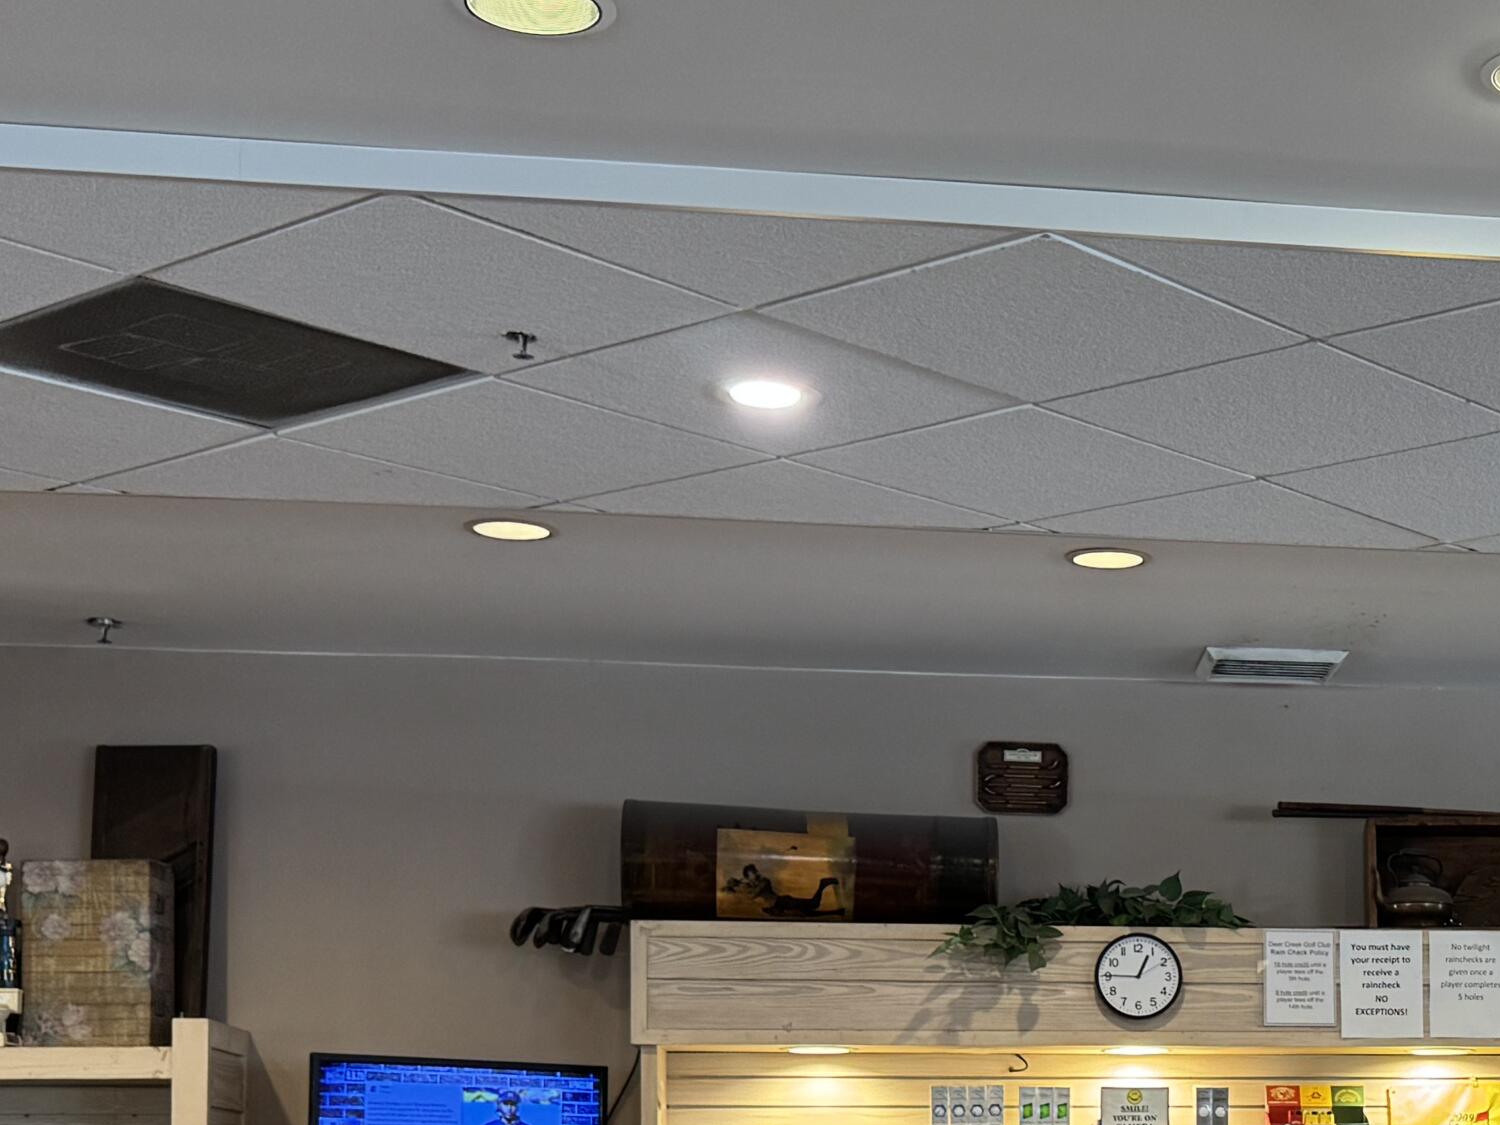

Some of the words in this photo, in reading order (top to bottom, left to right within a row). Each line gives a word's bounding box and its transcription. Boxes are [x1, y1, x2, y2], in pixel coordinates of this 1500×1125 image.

[1133, 944, 1143, 953] 12
[1351, 943, 1367, 951] You
[1391, 943, 1411, 951] have
[1463, 944, 1490, 952] twilight
[1109, 958, 1119, 967] 10
[1160, 957, 1168, 967] 2
[1351, 957, 1369, 965] your
[1371, 956, 1400, 965] receipt
[1165, 972, 1172, 981] 3
[1362, 981, 1401, 989] raincheck
[1109, 986, 1117, 996] 8
[1121, 997, 1127, 1006] 7
[1150, 997, 1157, 1006] 5
[1375, 995, 1388, 1003] NO
[1135, 1001, 1142, 1010] 6
[1355, 1008, 1408, 1016] EXCEPTIONS!
[1120, 1105, 1149, 1113] SMILE!
